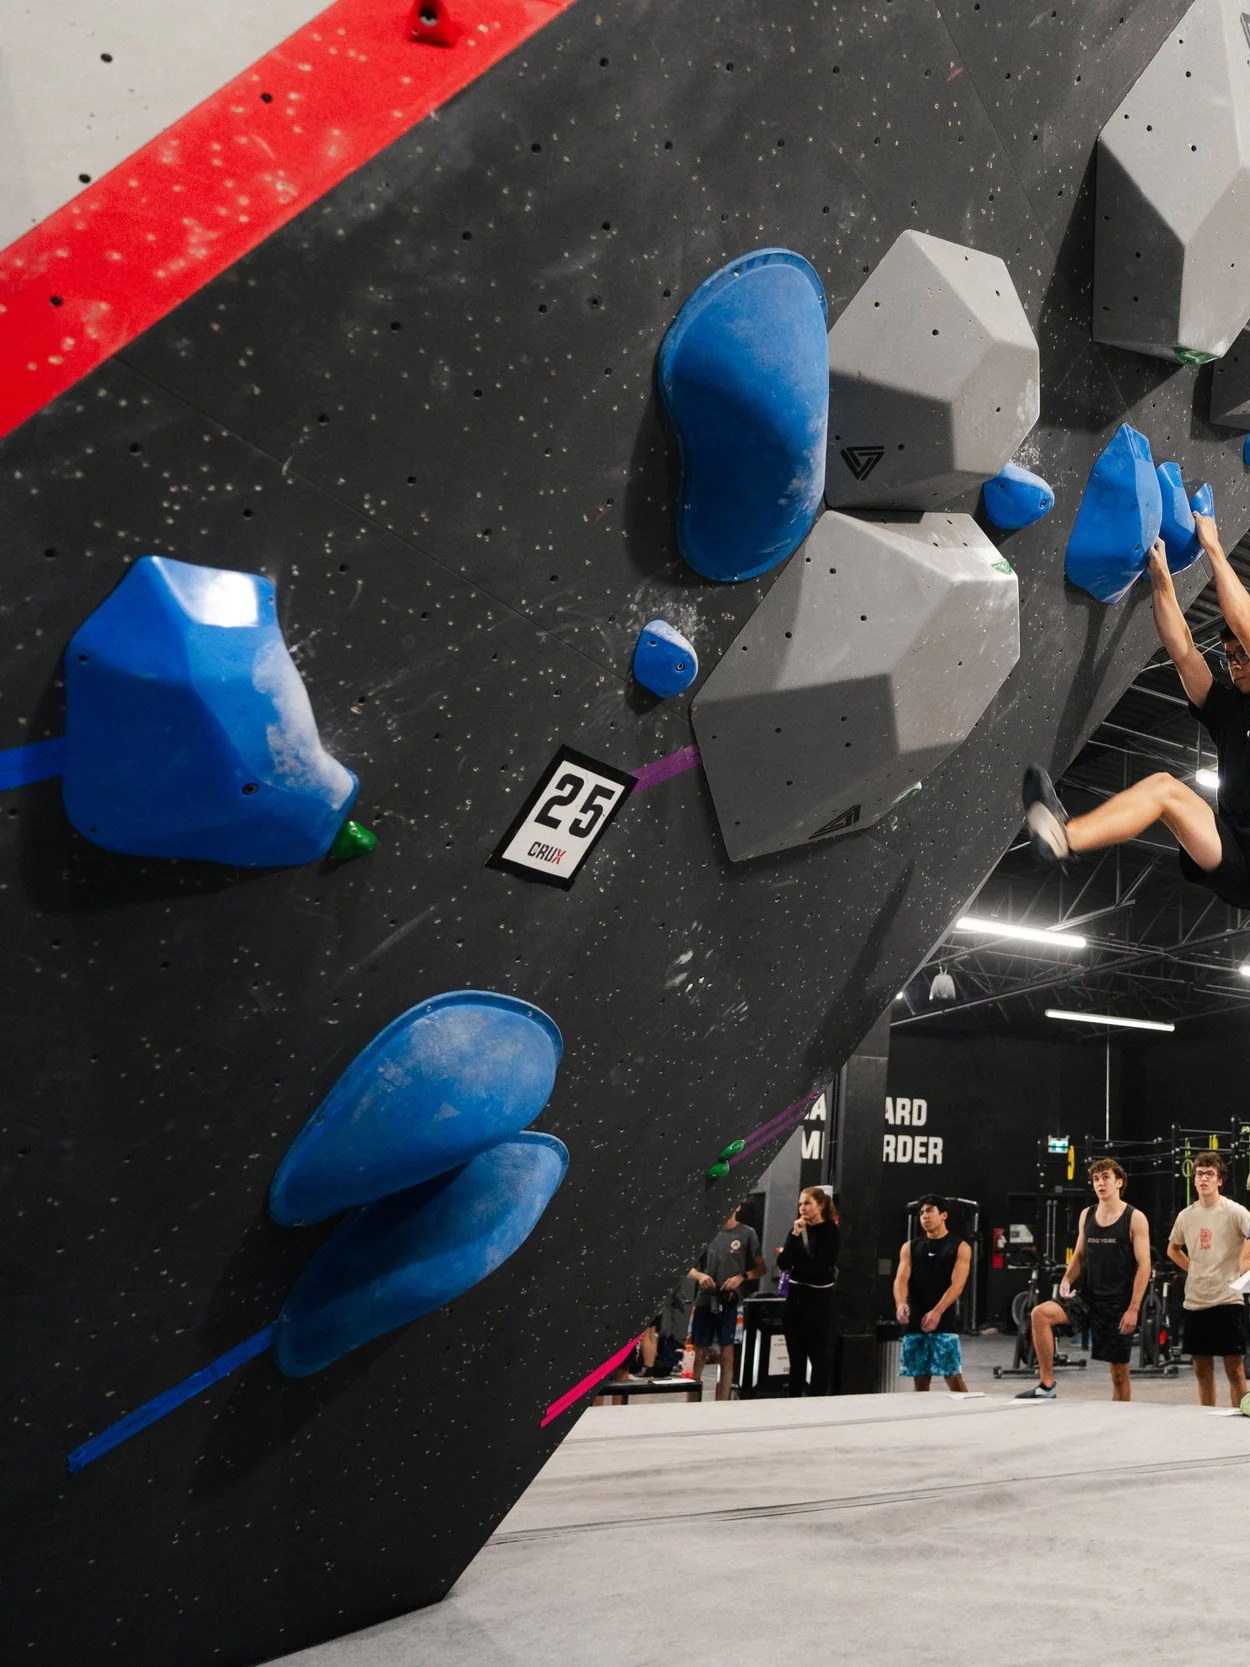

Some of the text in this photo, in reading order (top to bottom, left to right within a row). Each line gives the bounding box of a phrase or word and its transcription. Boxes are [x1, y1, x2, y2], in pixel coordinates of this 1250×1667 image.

[534, 773, 615, 838] 25
[528, 841, 566, 865] CRUX
[804, 1093, 826, 1120] A
